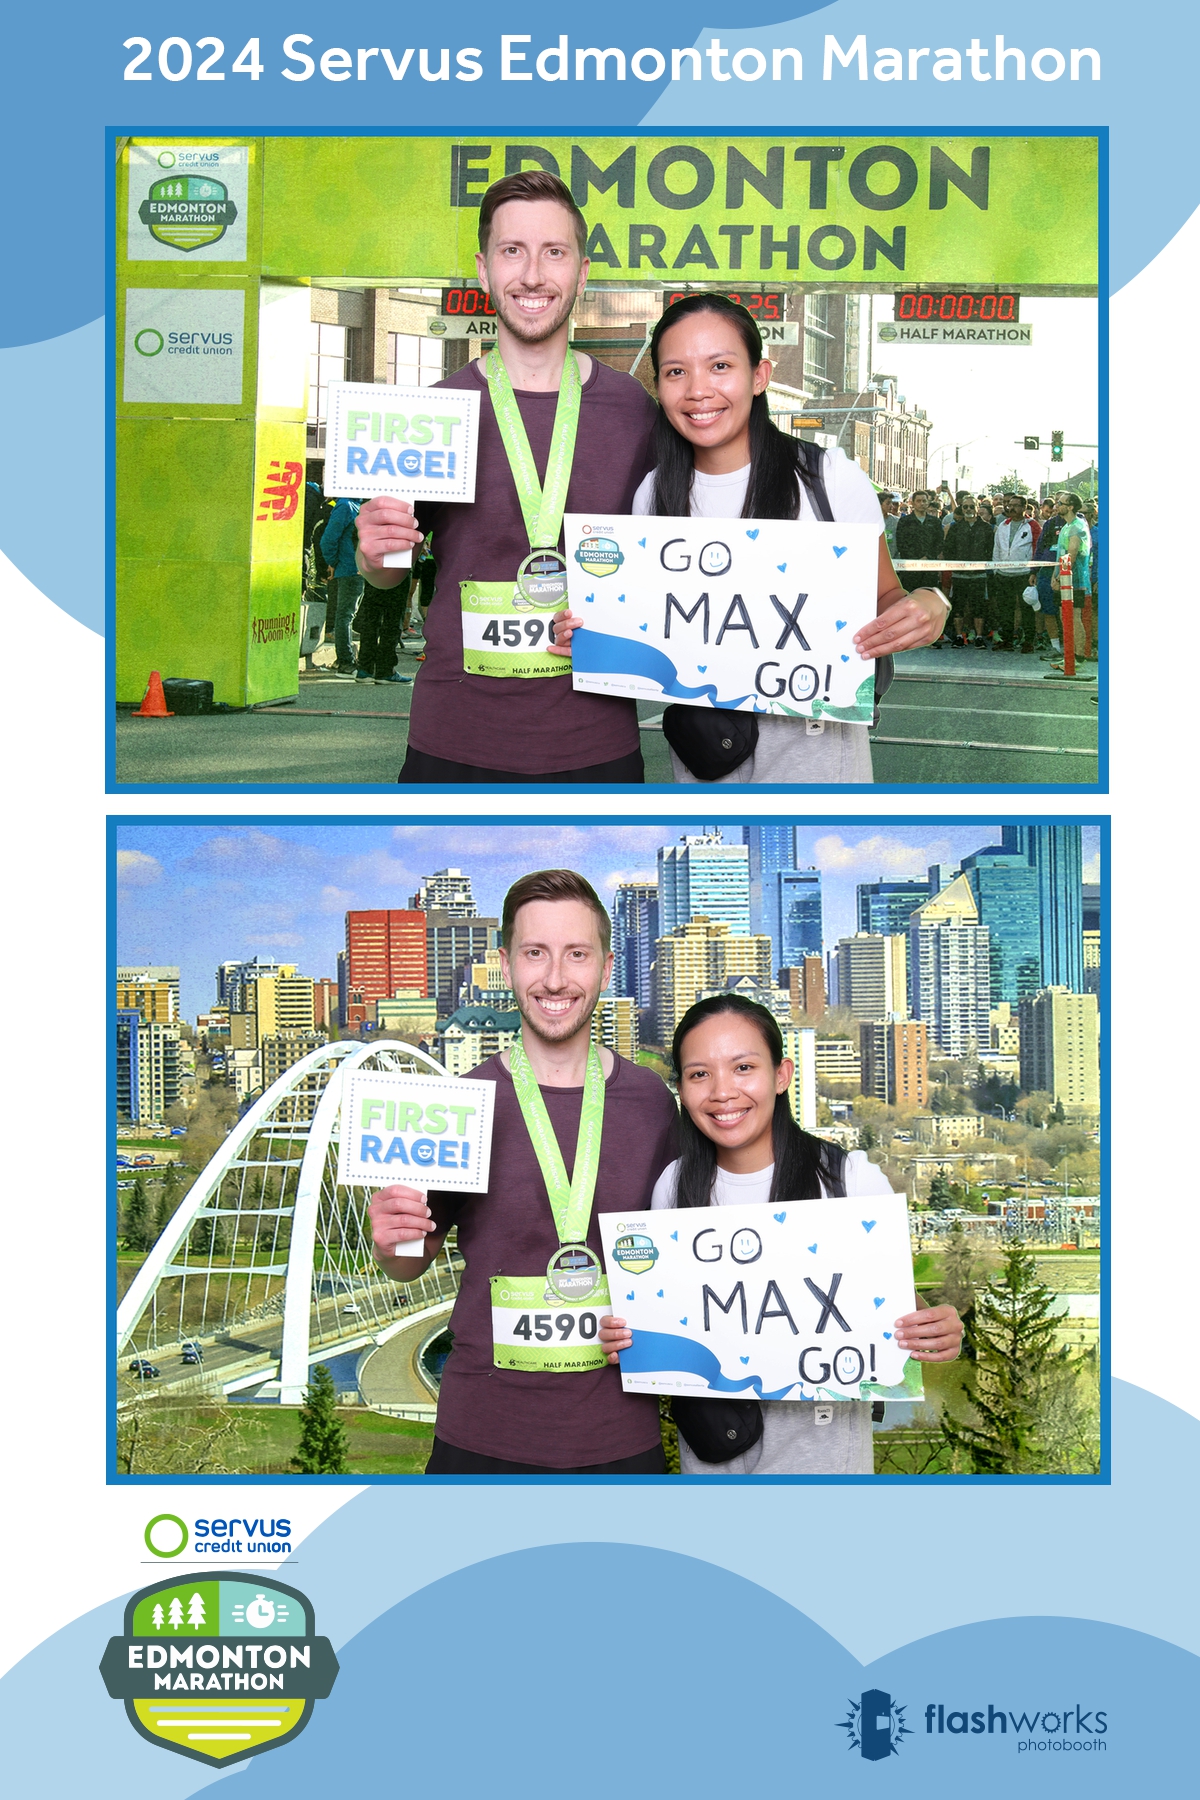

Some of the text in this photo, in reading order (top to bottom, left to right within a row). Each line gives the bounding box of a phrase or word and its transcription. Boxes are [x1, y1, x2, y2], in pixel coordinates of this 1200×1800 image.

[178, 152, 219, 160] servus
[149, 203, 226, 213] EDMONTON
[160, 214, 215, 222] MARATHON
[586, 223, 906, 271] ARATHON
[168, 332, 233, 345] servus
[168, 345, 233, 355] credit union
[900, 328, 1030, 341] HALF MARATHON
[347, 410, 461, 446] FIRST
[346, 446, 456, 479] RACE!
[509, 423, 523, 461] MARATHON
[520, 461, 532, 495] FINISHER
[555, 441, 567, 479] MARATHON
[548, 480, 559, 515] FINISHER
[580, 551, 619, 559] EDMONTON
[660, 538, 732, 577] GO
[664, 592, 812, 651] MAX
[533, 664, 572, 673] MARATHON
[755, 661, 832, 702] GO!
[361, 1098, 476, 1135] FIRST
[360, 1134, 470, 1169] RACE!
[528, 1100, 563, 1189] HALF MARATHON FINISHER
[581, 1138, 592, 1176] MARATHON
[576, 1177, 586, 1211] FINISHER
[693, 1228, 762, 1264] GO
[702, 1273, 852, 1335] MAX
[513, 1312, 597, 1341] 4590
[564, 1359, 603, 1367] MARATHON
[799, 1344, 877, 1385] GO!
